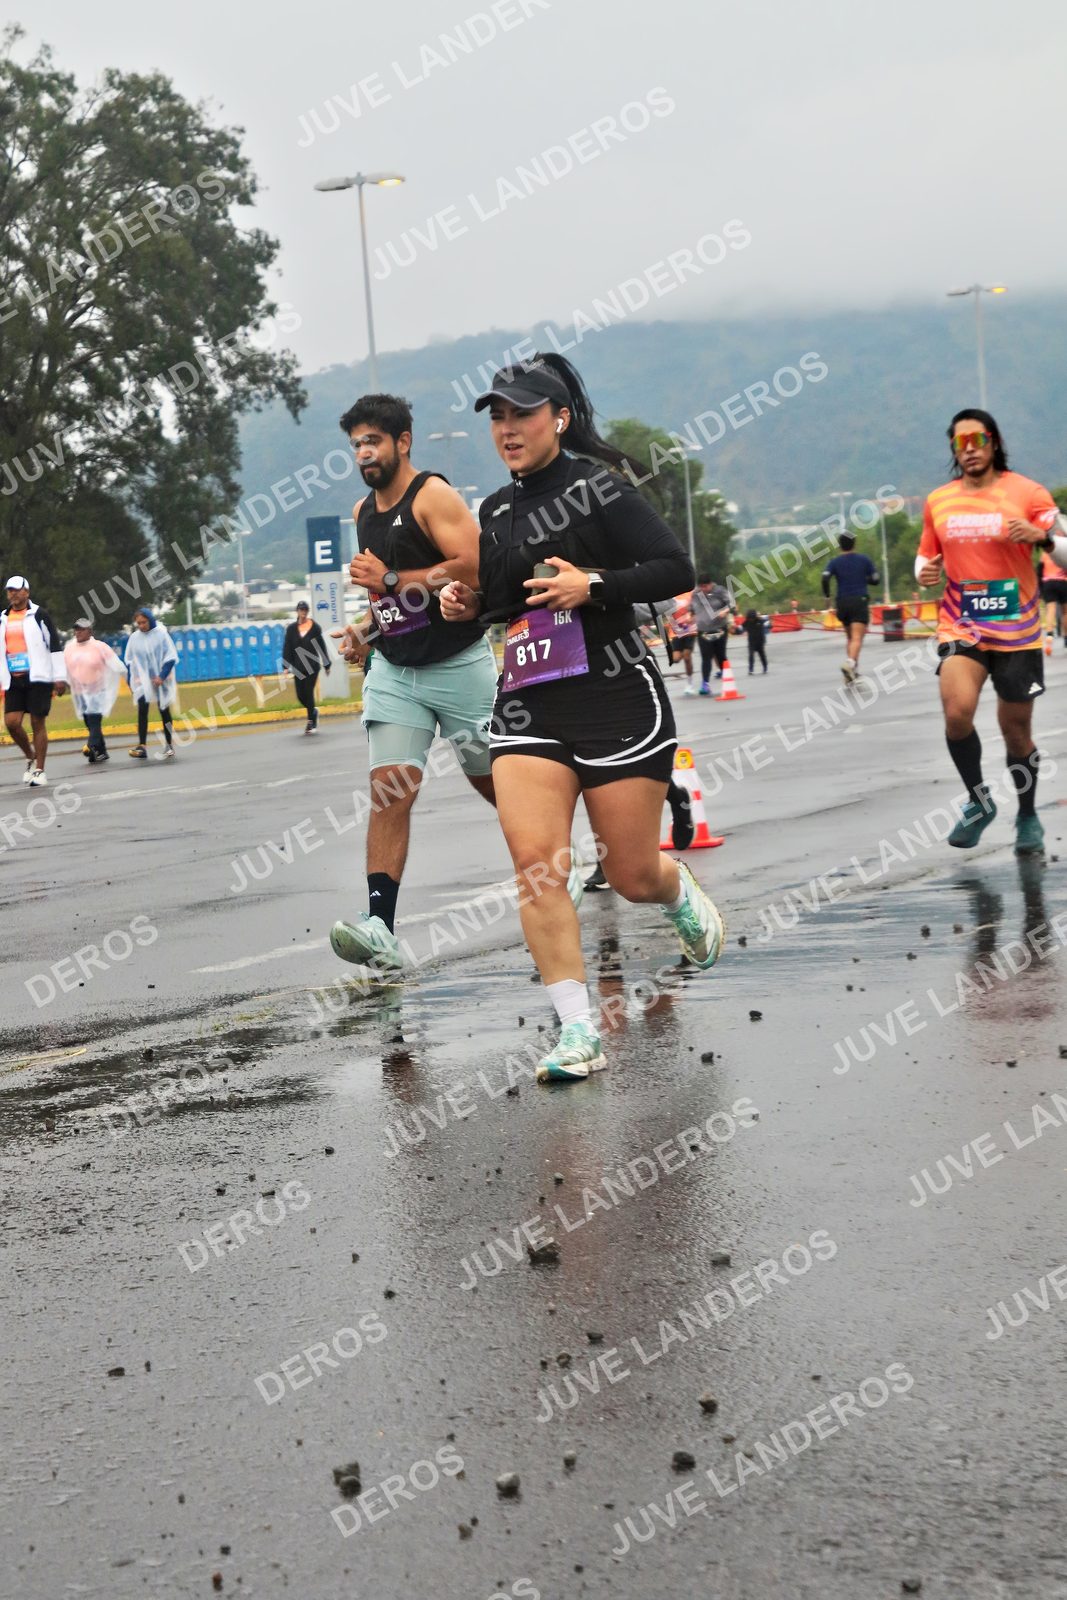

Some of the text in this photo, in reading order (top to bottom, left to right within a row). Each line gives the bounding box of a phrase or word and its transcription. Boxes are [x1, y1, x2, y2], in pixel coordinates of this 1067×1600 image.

[315, 540, 333, 565] E
[330, 582, 339, 623] General
[971, 597, 1008, 610] 1055
[554, 610, 572, 626] 15K
[516, 639, 551, 666] 817
